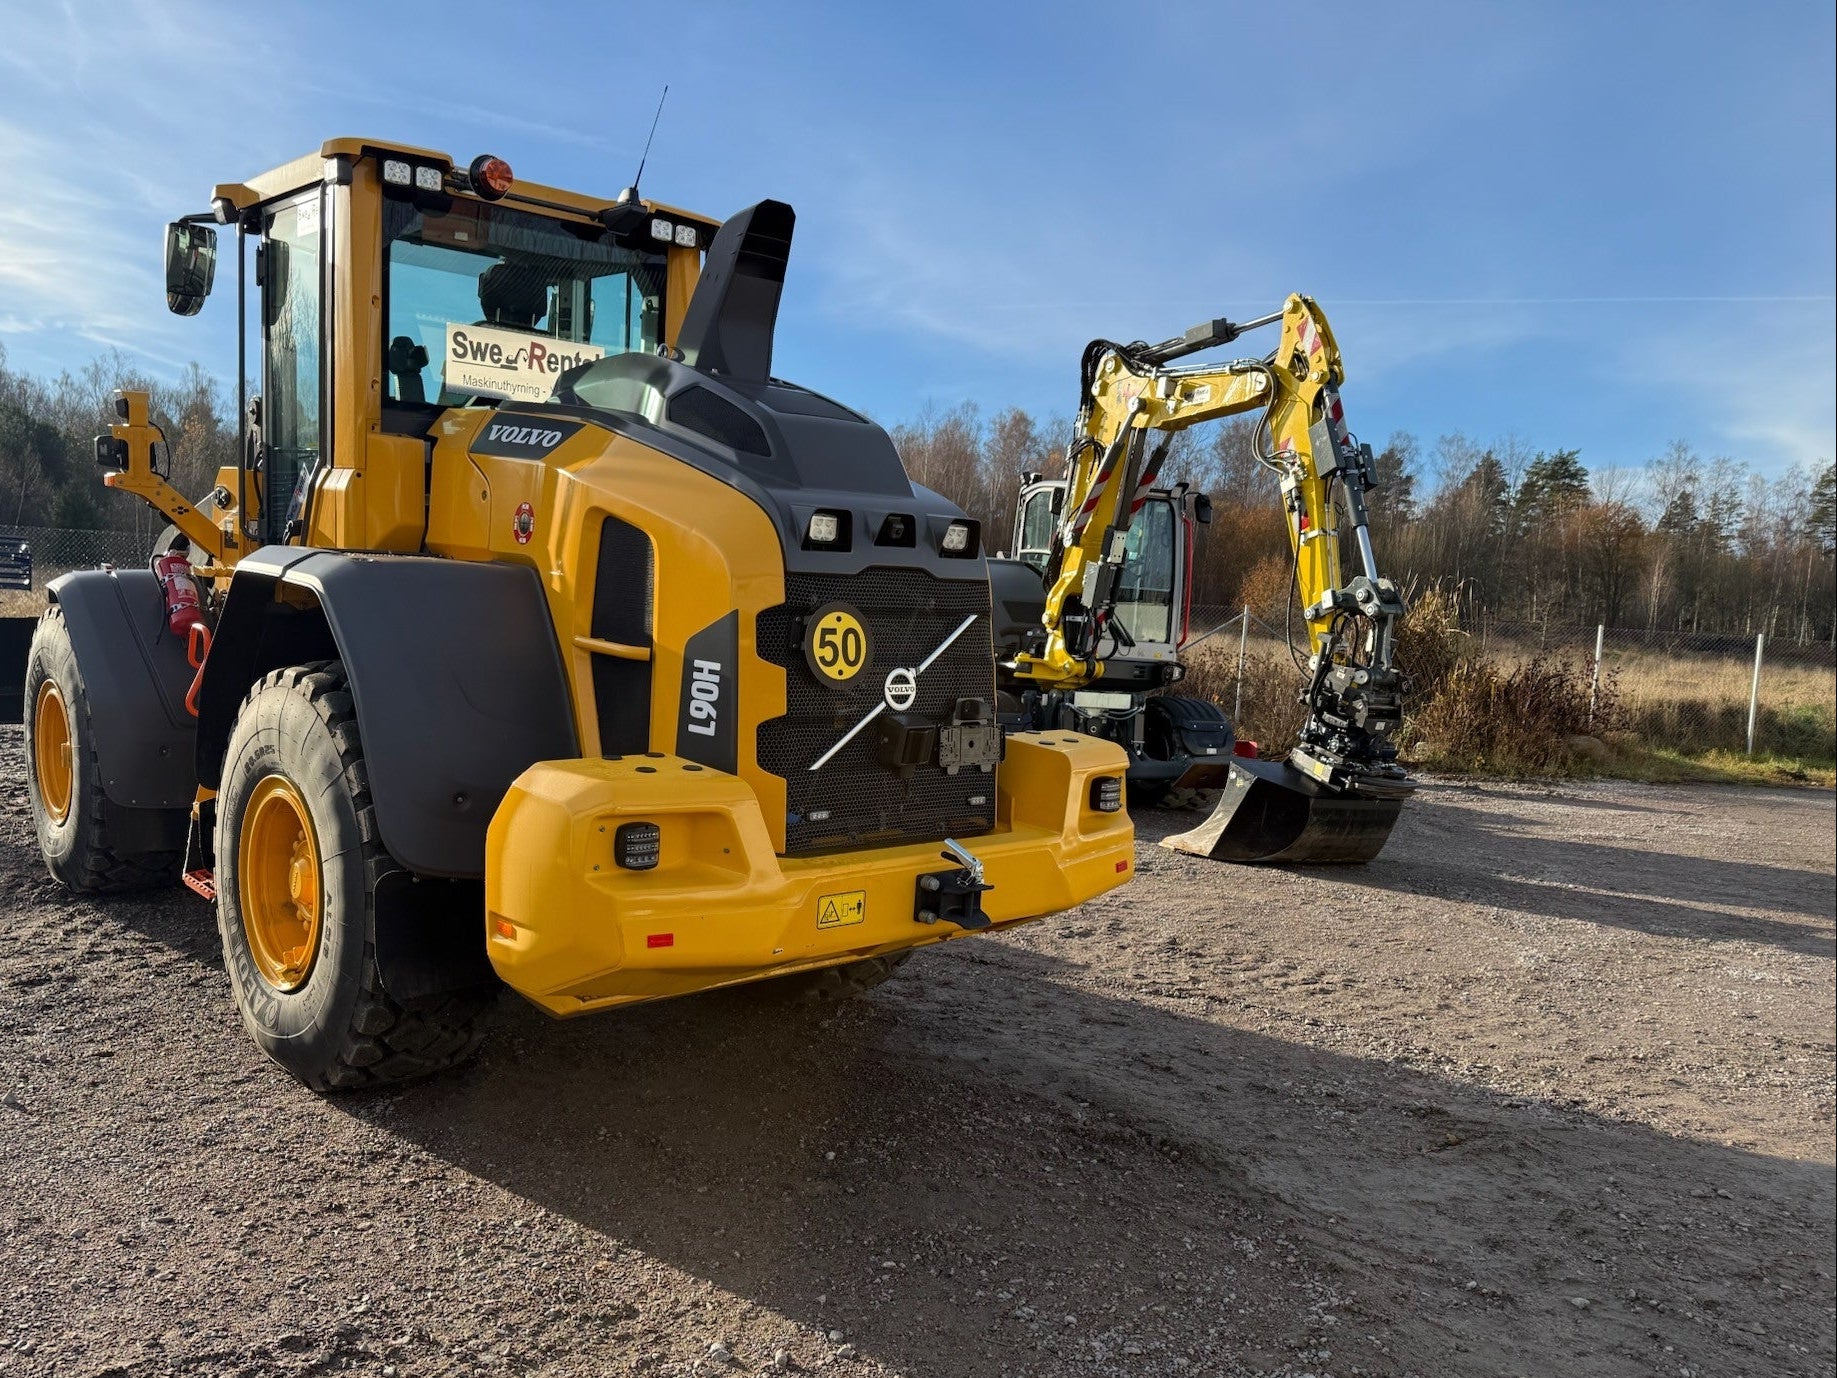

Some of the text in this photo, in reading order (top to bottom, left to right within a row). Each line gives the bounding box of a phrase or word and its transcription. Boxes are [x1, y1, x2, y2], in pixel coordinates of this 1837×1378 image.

[452, 331, 600, 373] Swe Rent
[462, 374, 540, 398] Maskinuthyrning
[488, 424, 562, 448] VOLVO
[818, 627, 862, 668] 50
[687, 659, 722, 738] L90H
[886, 686, 915, 694] VOLVO
